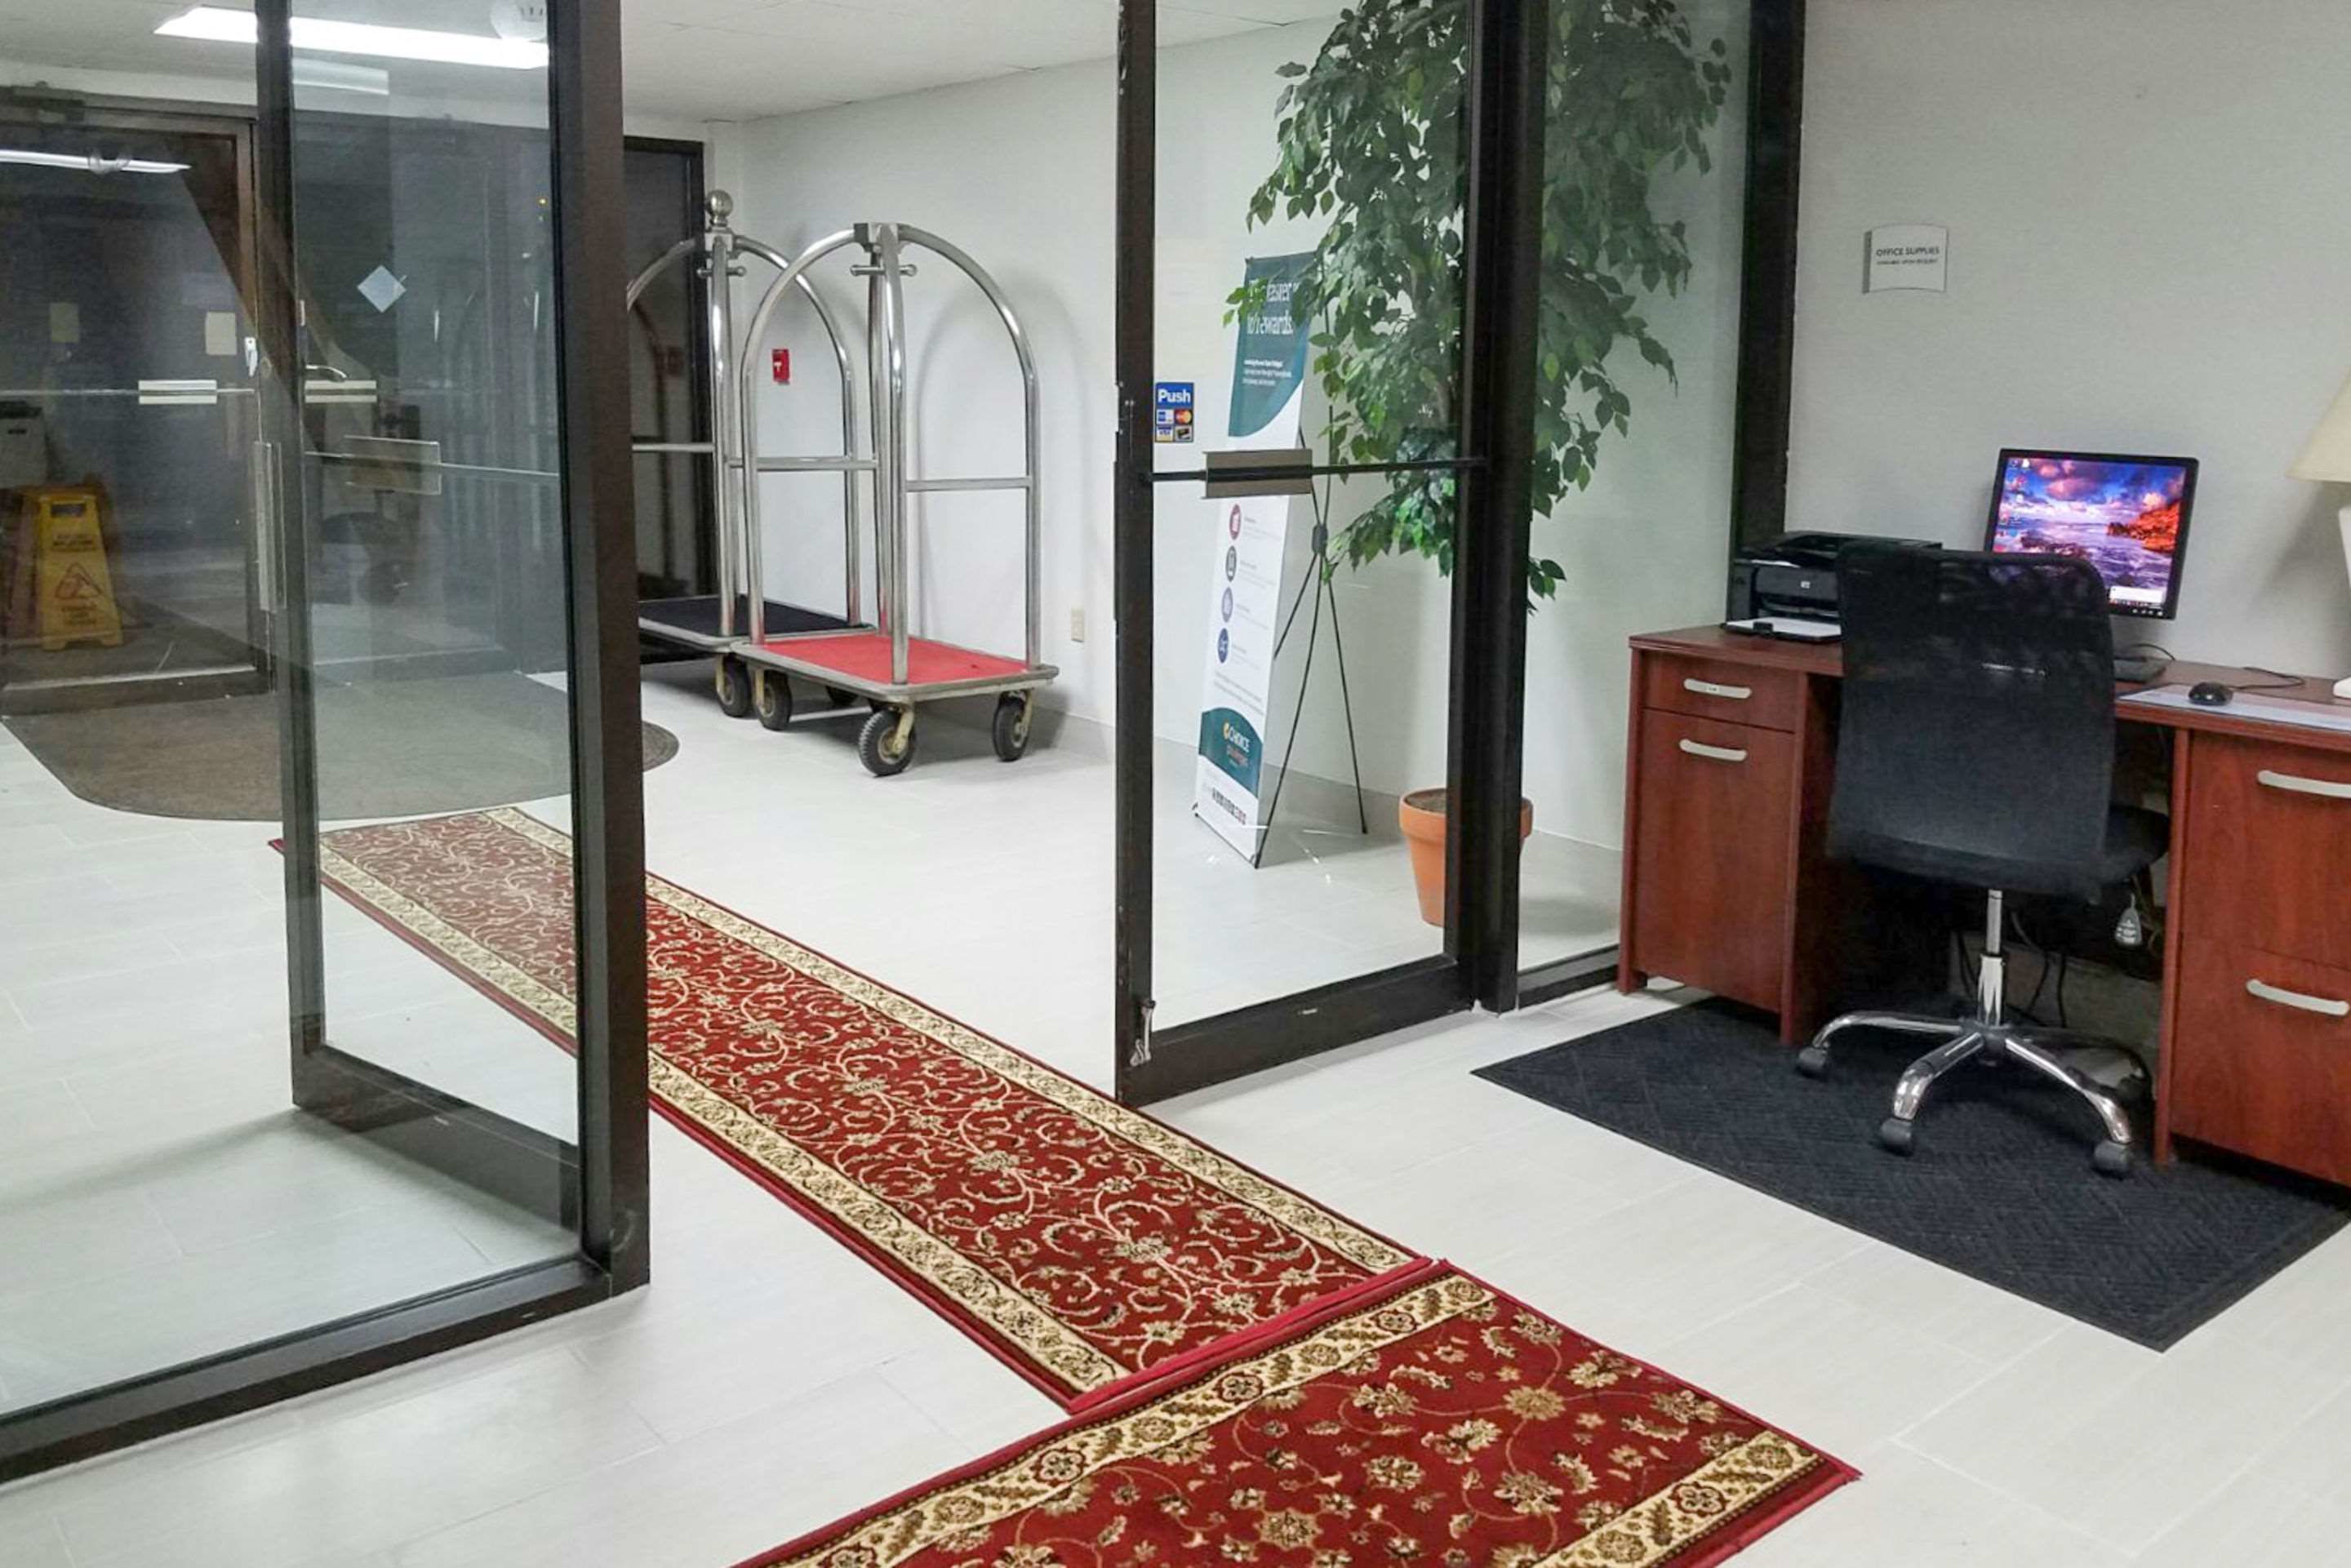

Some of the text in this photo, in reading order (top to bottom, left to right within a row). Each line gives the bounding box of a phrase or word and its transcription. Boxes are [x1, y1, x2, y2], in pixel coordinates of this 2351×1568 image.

[1876, 247, 1940, 256] OFFICE SUPPLIES
[1158, 389, 1191, 403] Push
